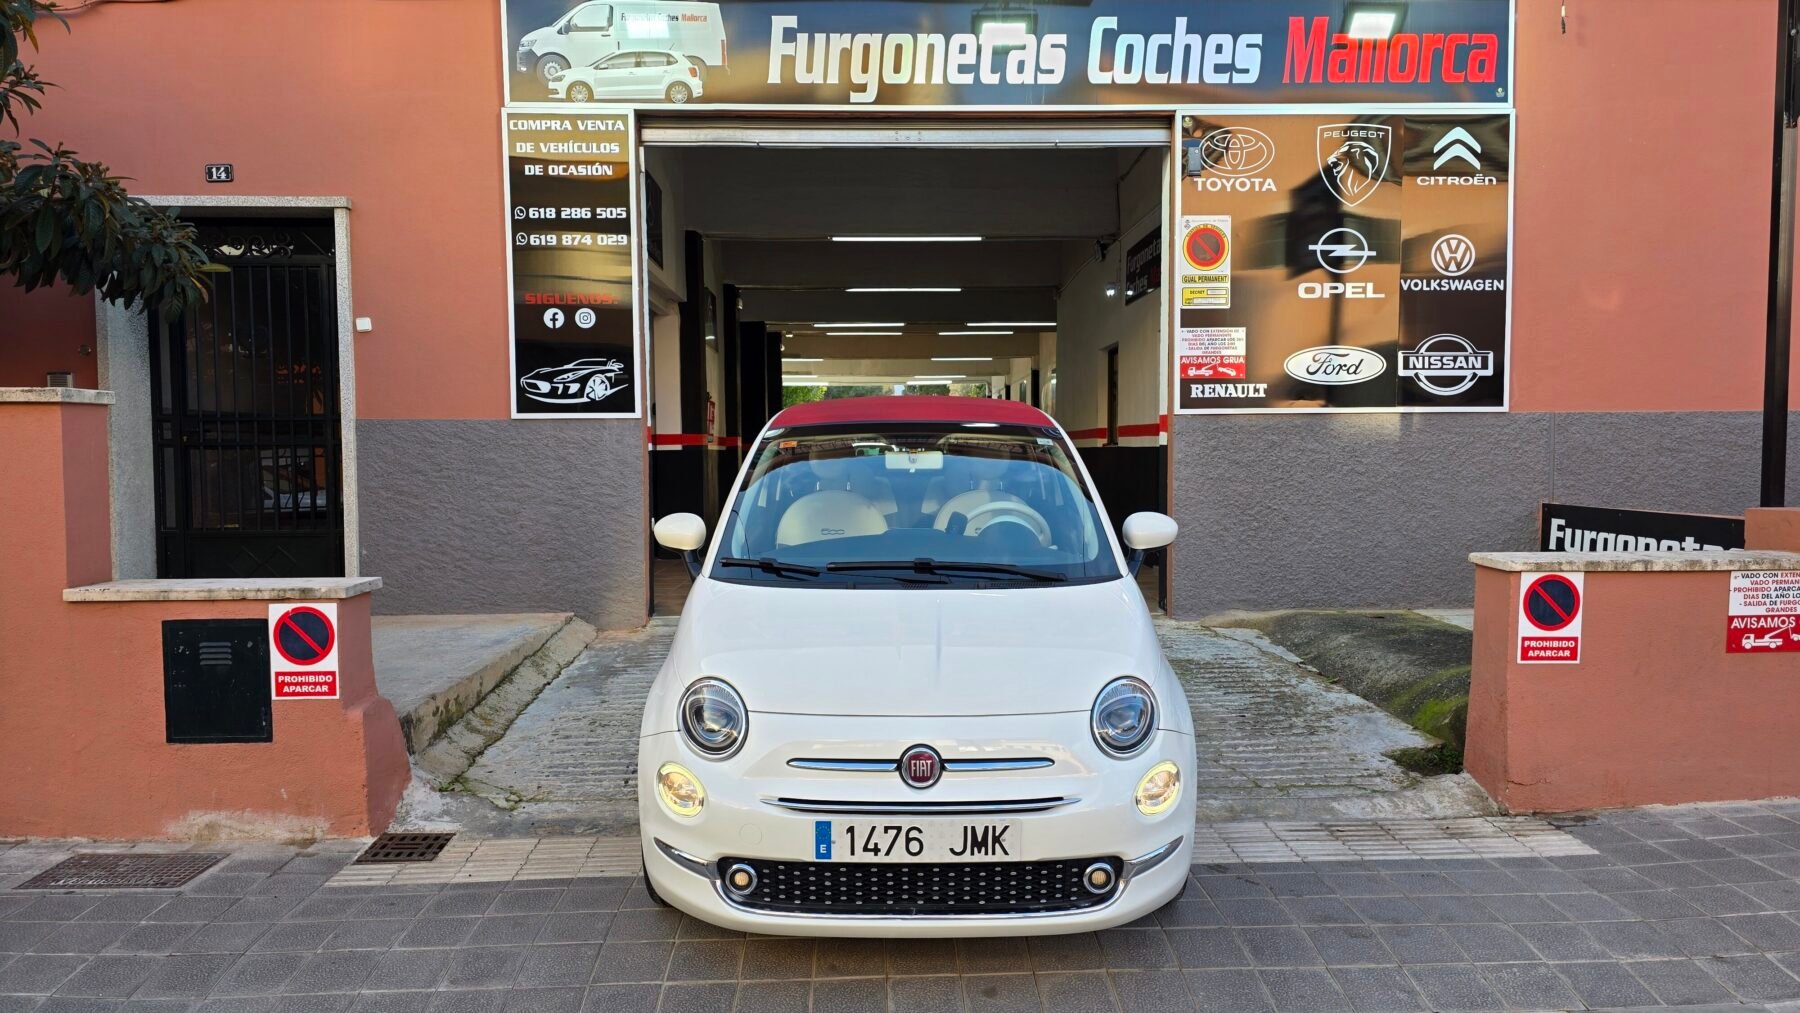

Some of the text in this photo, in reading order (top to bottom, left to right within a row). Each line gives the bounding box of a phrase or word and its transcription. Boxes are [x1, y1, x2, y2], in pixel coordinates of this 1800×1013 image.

[767, 15, 1499, 103] Furgonetas Coches Mallorca
[509, 119, 625, 131] COMPRA VENTA
[1323, 129, 1386, 139] PEUGEOT
[516, 140, 620, 153] DE VEHÍCULOS
[211, 167, 227, 179] 14
[524, 162, 613, 176] DE OCASIÓN
[1193, 177, 1278, 192] TOYOTA
[528, 207, 627, 219] 618 286 505
[529, 234, 628, 246] 619 874 029
[1298, 281, 1386, 299] OPEL
[1400, 278, 1505, 292] VOLKSWAGEN
[1180, 356, 1221, 364] AVISAMOS
[1306, 351, 1364, 376] Ford
[1408, 356, 1482, 369] NISSAN
[1190, 383, 1267, 398] RENAULT
[1775, 591, 1791, 599] AÑO
[1731, 617, 1796, 629] AVISAMOS
[1524, 639, 1576, 649] PROHIBIDO
[1527, 649, 1571, 658] APARCAR
[278, 674, 333, 683] PROHIBIDO
[282, 685, 329, 693] APARCAR
[911, 759, 933, 777] FIAT
[845, 824, 1011, 857] 1476 JMK
[819, 844, 827, 854] E
